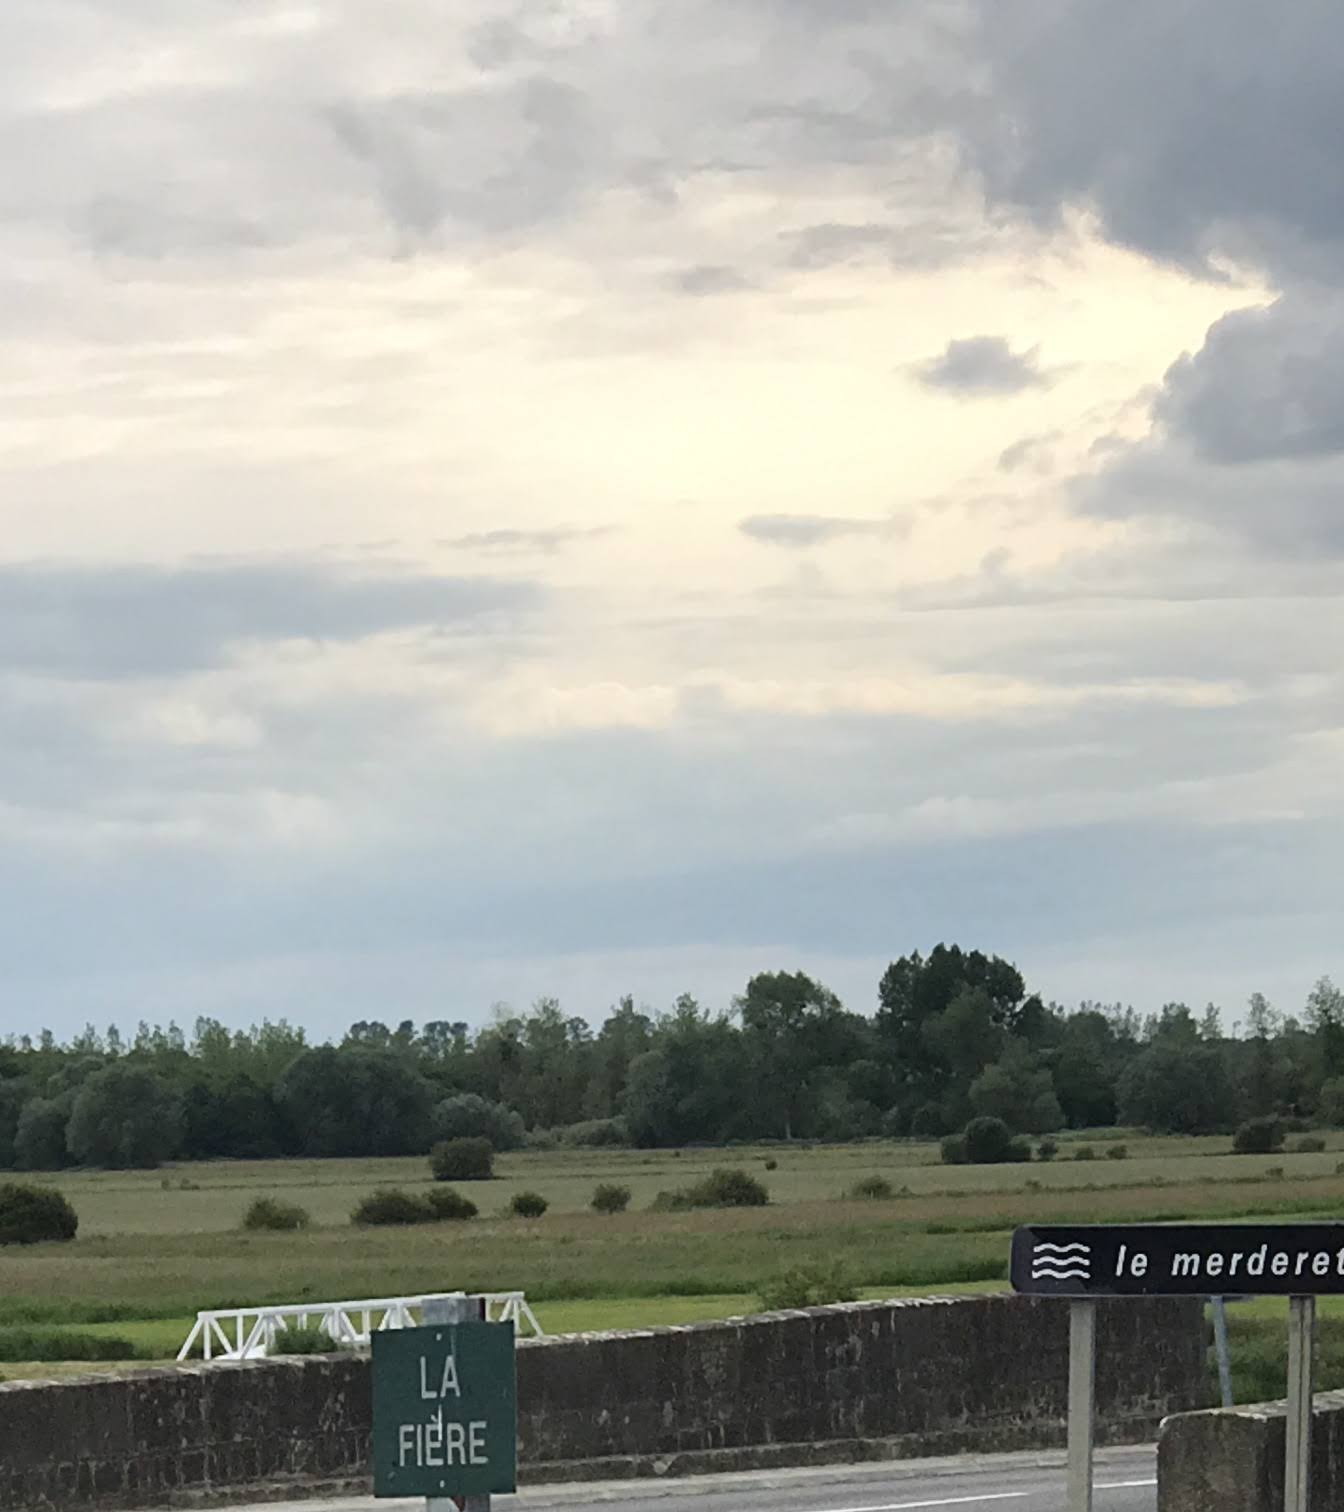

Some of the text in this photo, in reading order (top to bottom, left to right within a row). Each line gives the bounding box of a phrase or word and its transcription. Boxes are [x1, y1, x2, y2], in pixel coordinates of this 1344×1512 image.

[1116, 1244, 1148, 1277] le
[419, 1355, 461, 1400] LA
[398, 1414, 489, 1467] FIÈRE
